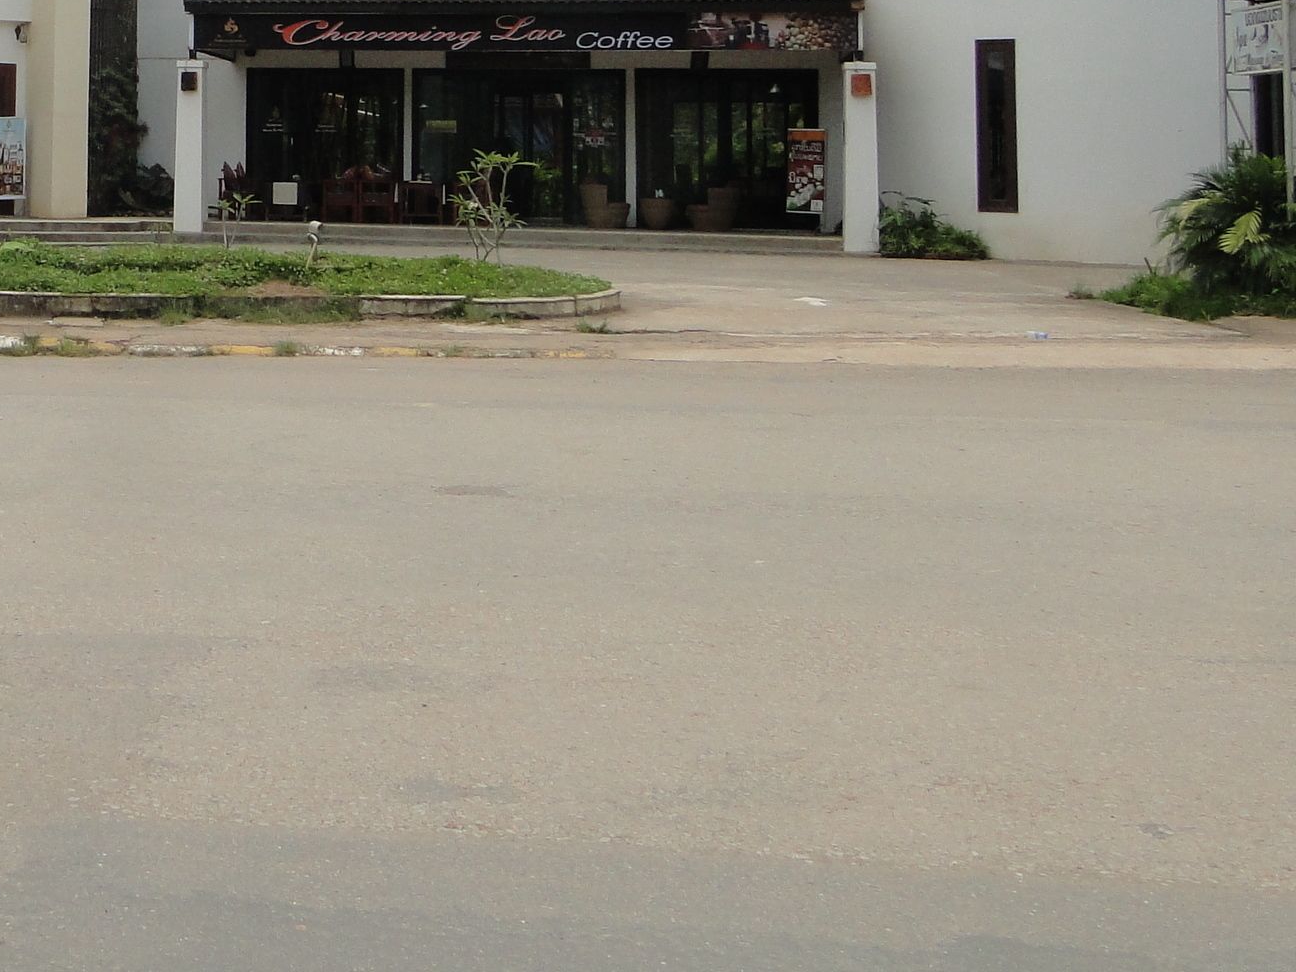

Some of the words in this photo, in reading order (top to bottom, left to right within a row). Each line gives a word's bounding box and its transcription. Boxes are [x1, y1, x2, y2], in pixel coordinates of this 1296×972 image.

[272, 19, 482, 51] Charming
[490, 14, 566, 42] Lao
[576, 30, 674, 49] Coffee
